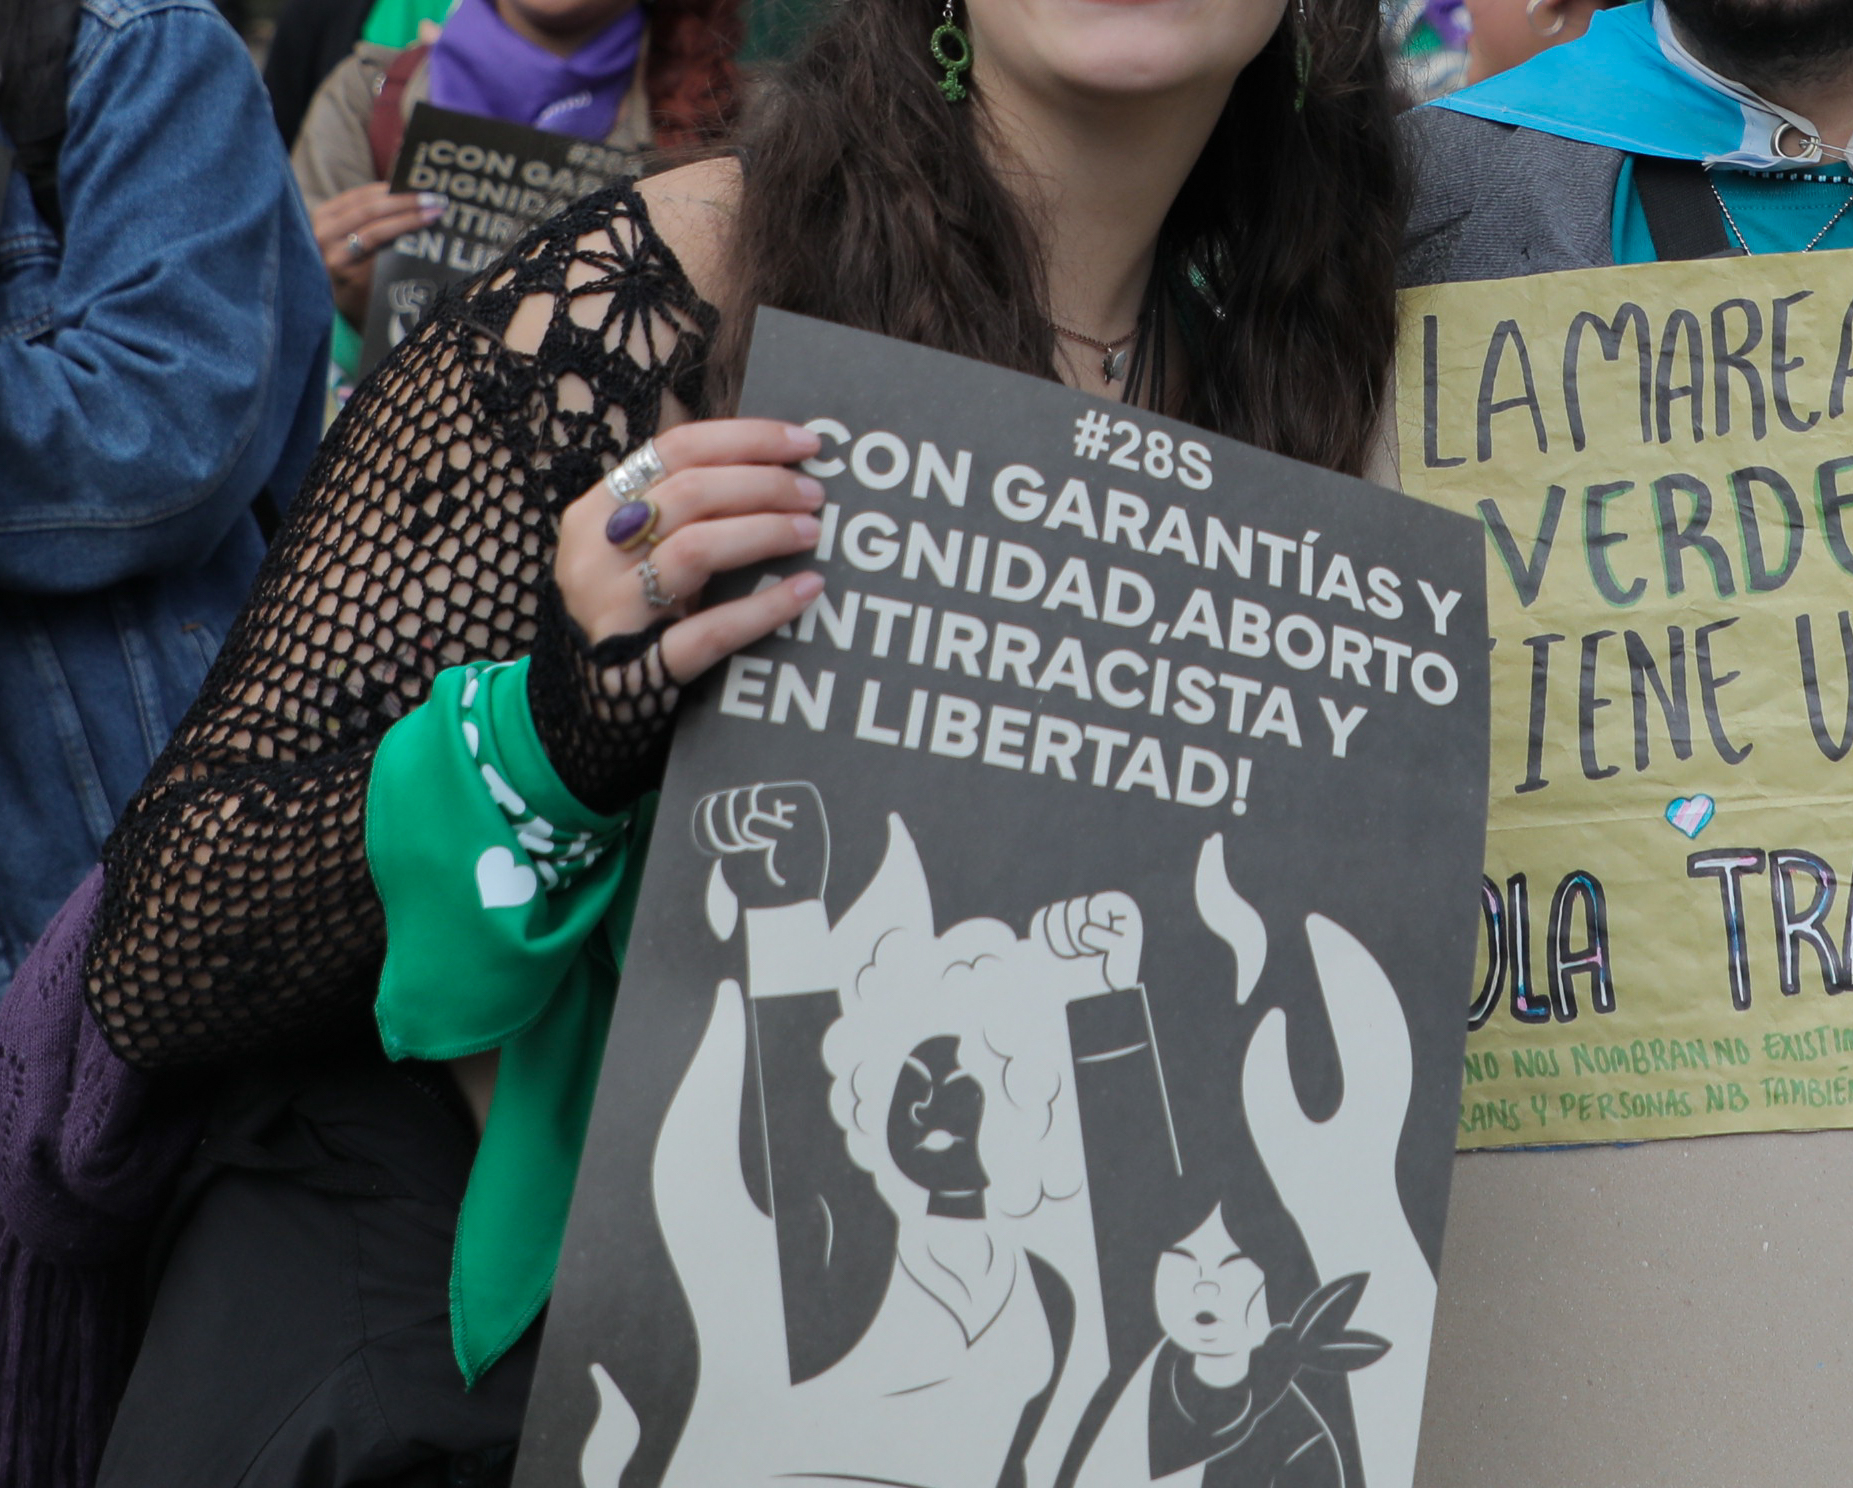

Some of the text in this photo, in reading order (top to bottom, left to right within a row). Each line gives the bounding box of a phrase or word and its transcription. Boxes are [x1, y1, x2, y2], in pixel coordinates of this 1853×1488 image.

[1074, 409, 1214, 491] #28S
[1422, 313, 1548, 469] LA
[800, 417, 1463, 638] CON GARANTÍAS Y
[718, 653, 1254, 816] EN LIBERTAD!
[1317, 697, 1368, 759] Y
[1489, 615, 1754, 795] IENE
[1458, 1098, 1523, 1133] RANS
[1531, 1093, 1549, 1128] Y
[1560, 1088, 1693, 1123] PERSONAS
[1705, 1081, 1750, 1114] NB
[1511, 1047, 1561, 1079] NOS
[1569, 1037, 1710, 1077] NOMBRAN
